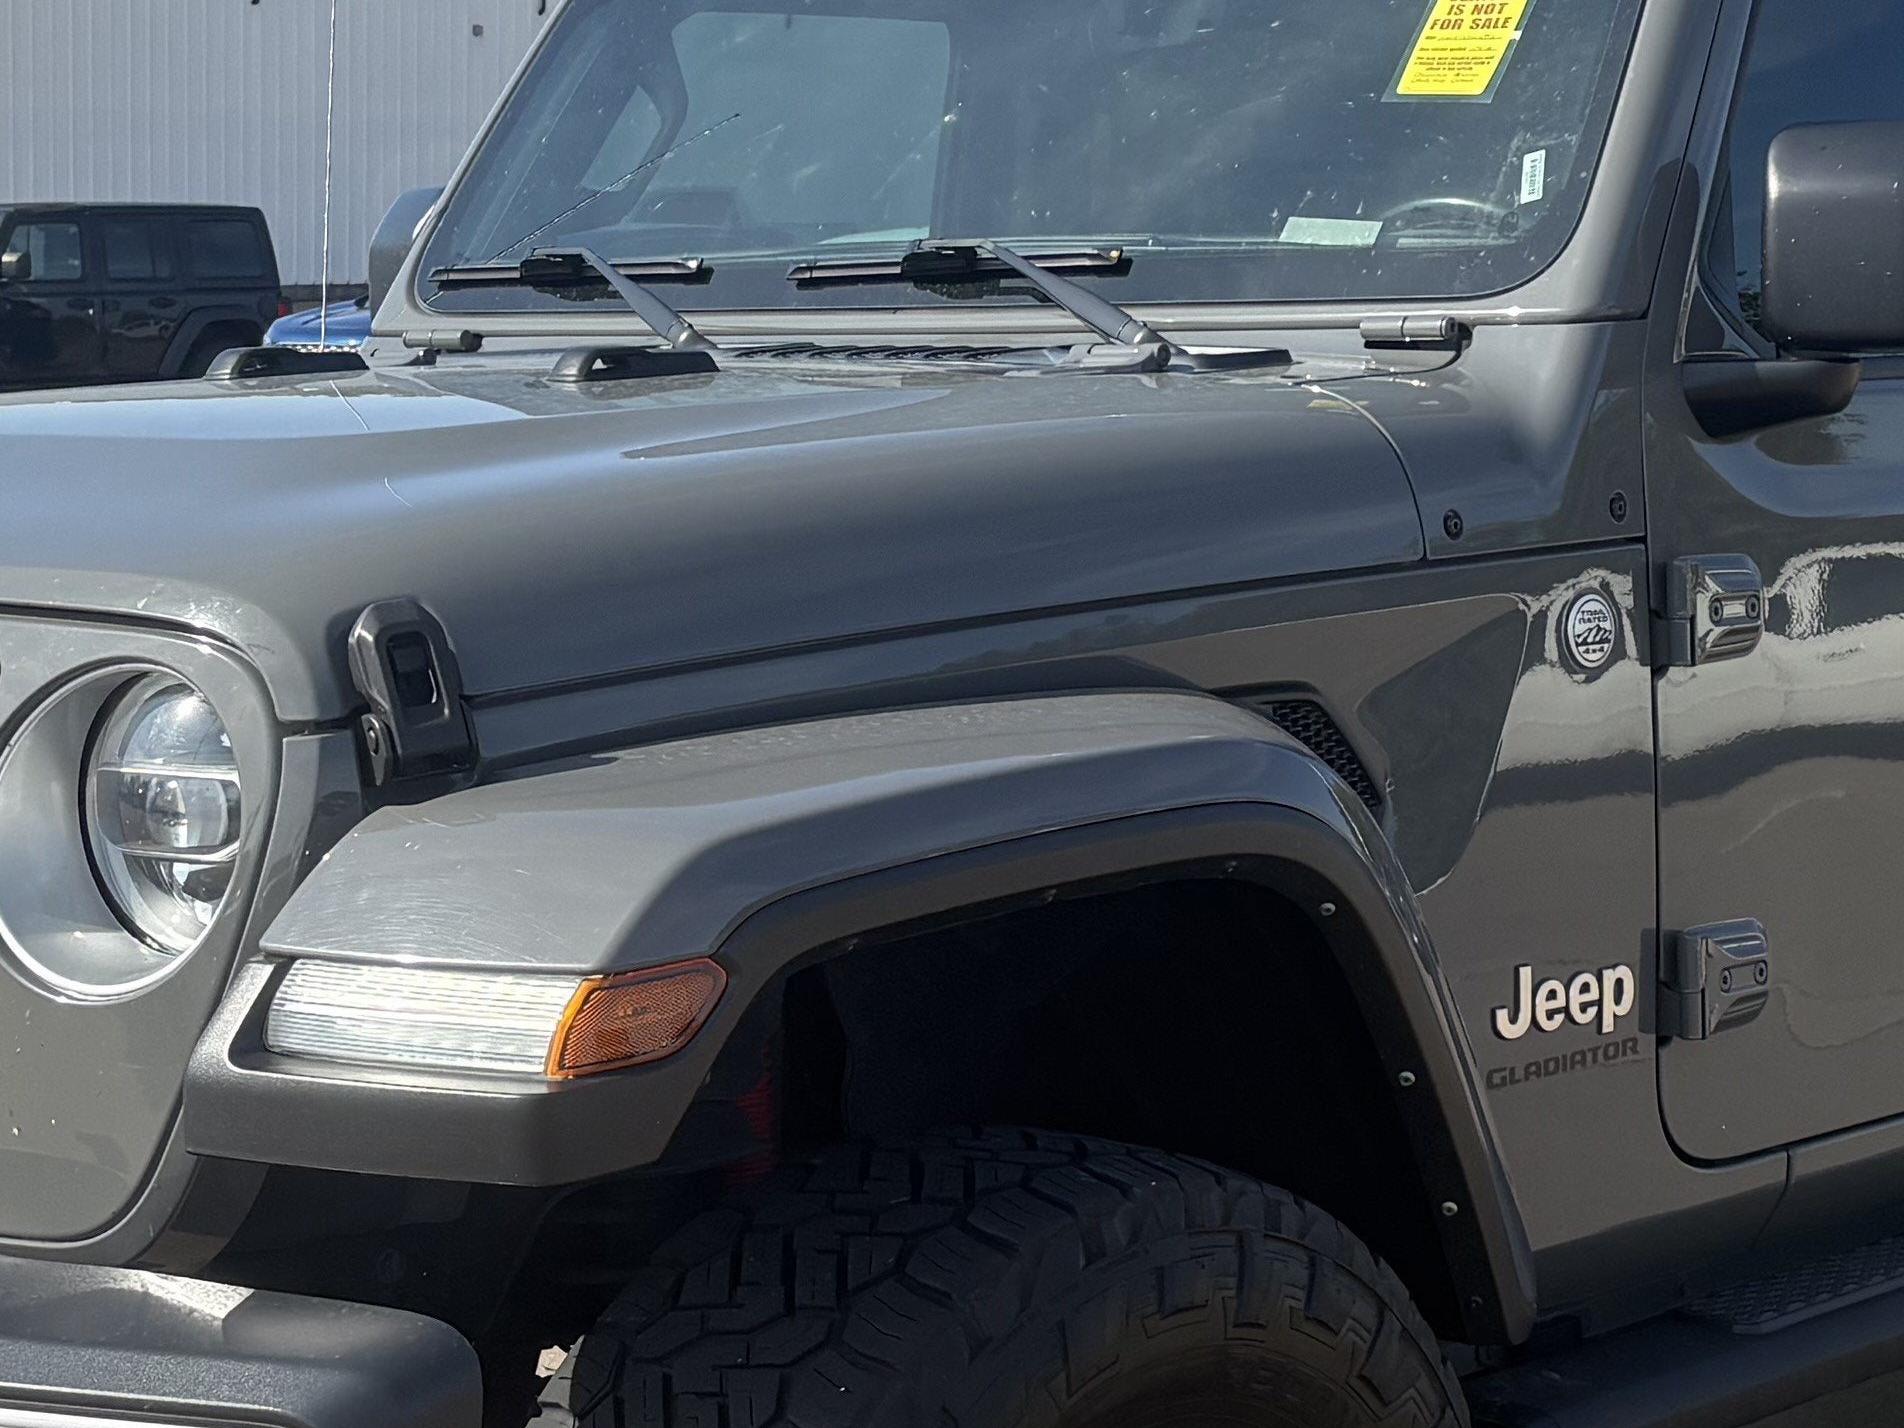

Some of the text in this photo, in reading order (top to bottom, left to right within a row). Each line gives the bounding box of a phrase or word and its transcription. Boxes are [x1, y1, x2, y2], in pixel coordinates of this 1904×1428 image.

[1429, 16, 1513, 30] FOR SALE
[1446, 2, 1509, 16] IS NOT
[1490, 962, 1635, 1041] Jeep
[1486, 1036, 1640, 1090] GLADIATOR
